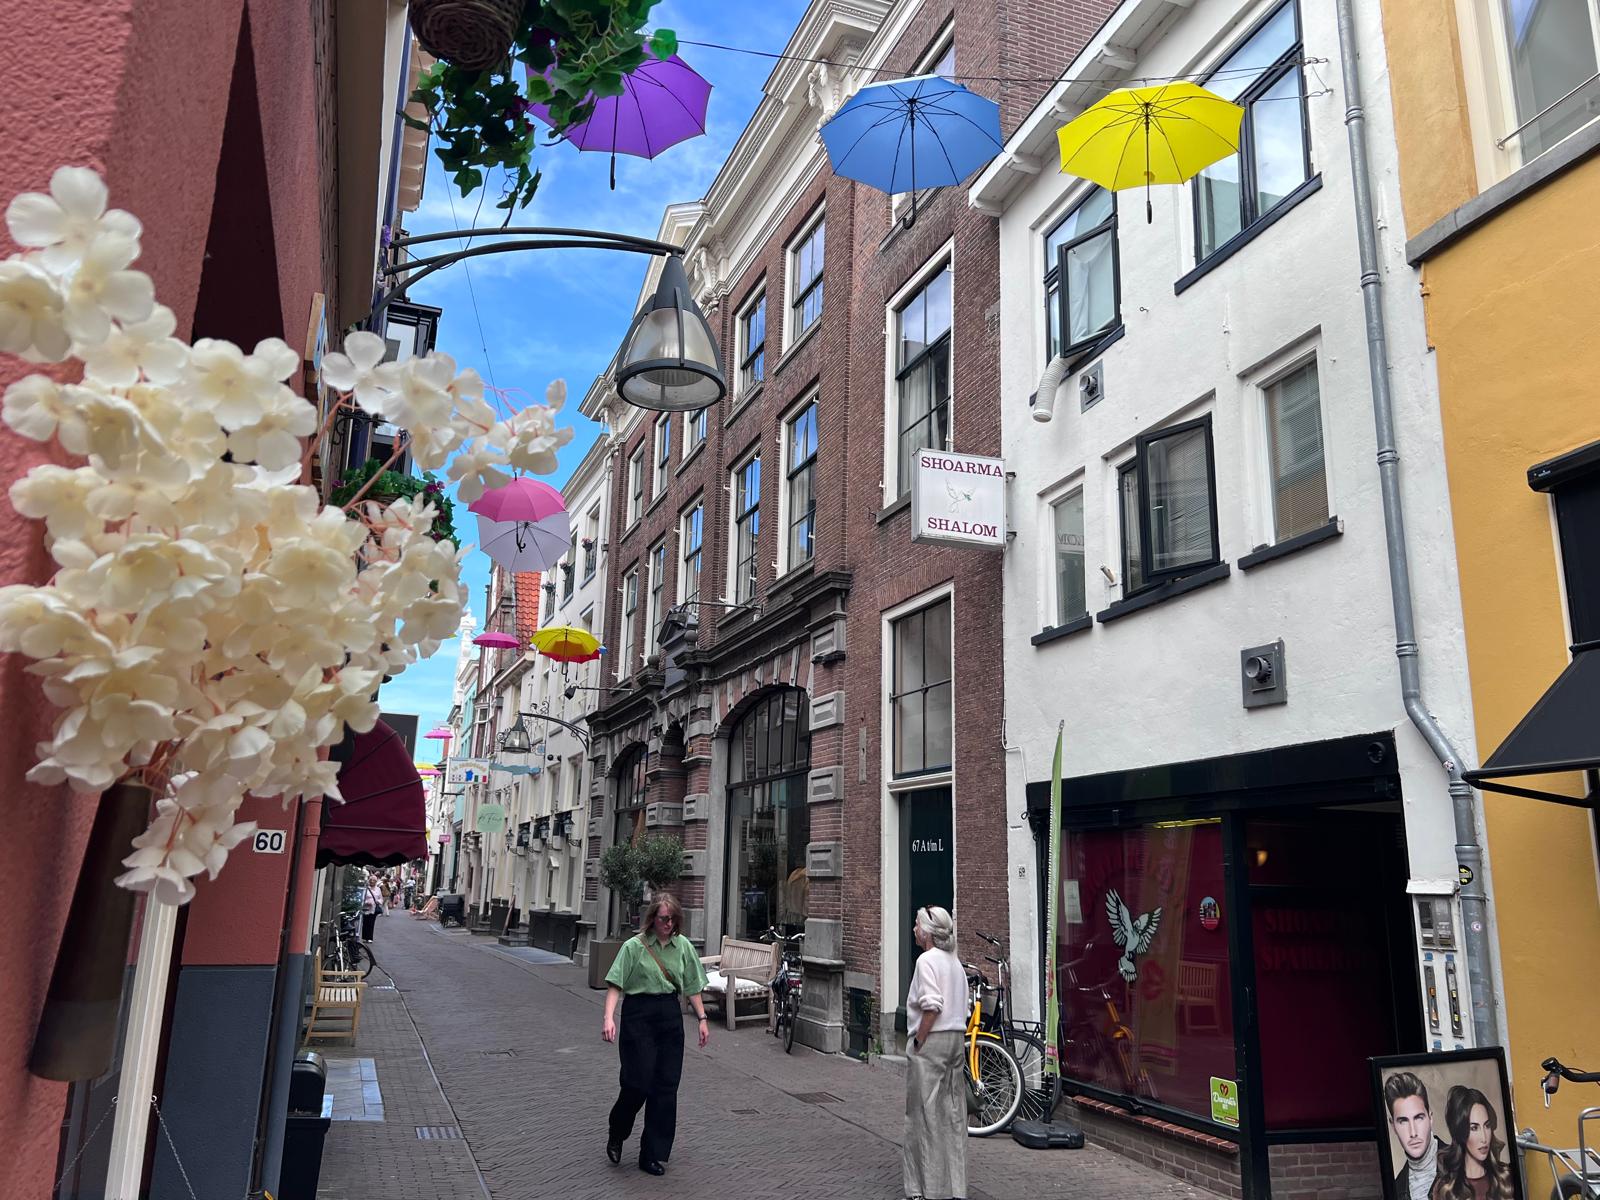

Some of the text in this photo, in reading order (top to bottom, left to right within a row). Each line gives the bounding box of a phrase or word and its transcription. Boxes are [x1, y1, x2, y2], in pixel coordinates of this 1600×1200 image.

[921, 456, 1003, 478] SHOARMA
[927, 517, 998, 538] SHALOM
[255, 831, 283, 851] 60
[912, 839, 920, 852] 67
[920, 840, 926, 852] A
[938, 838, 944, 852] L
